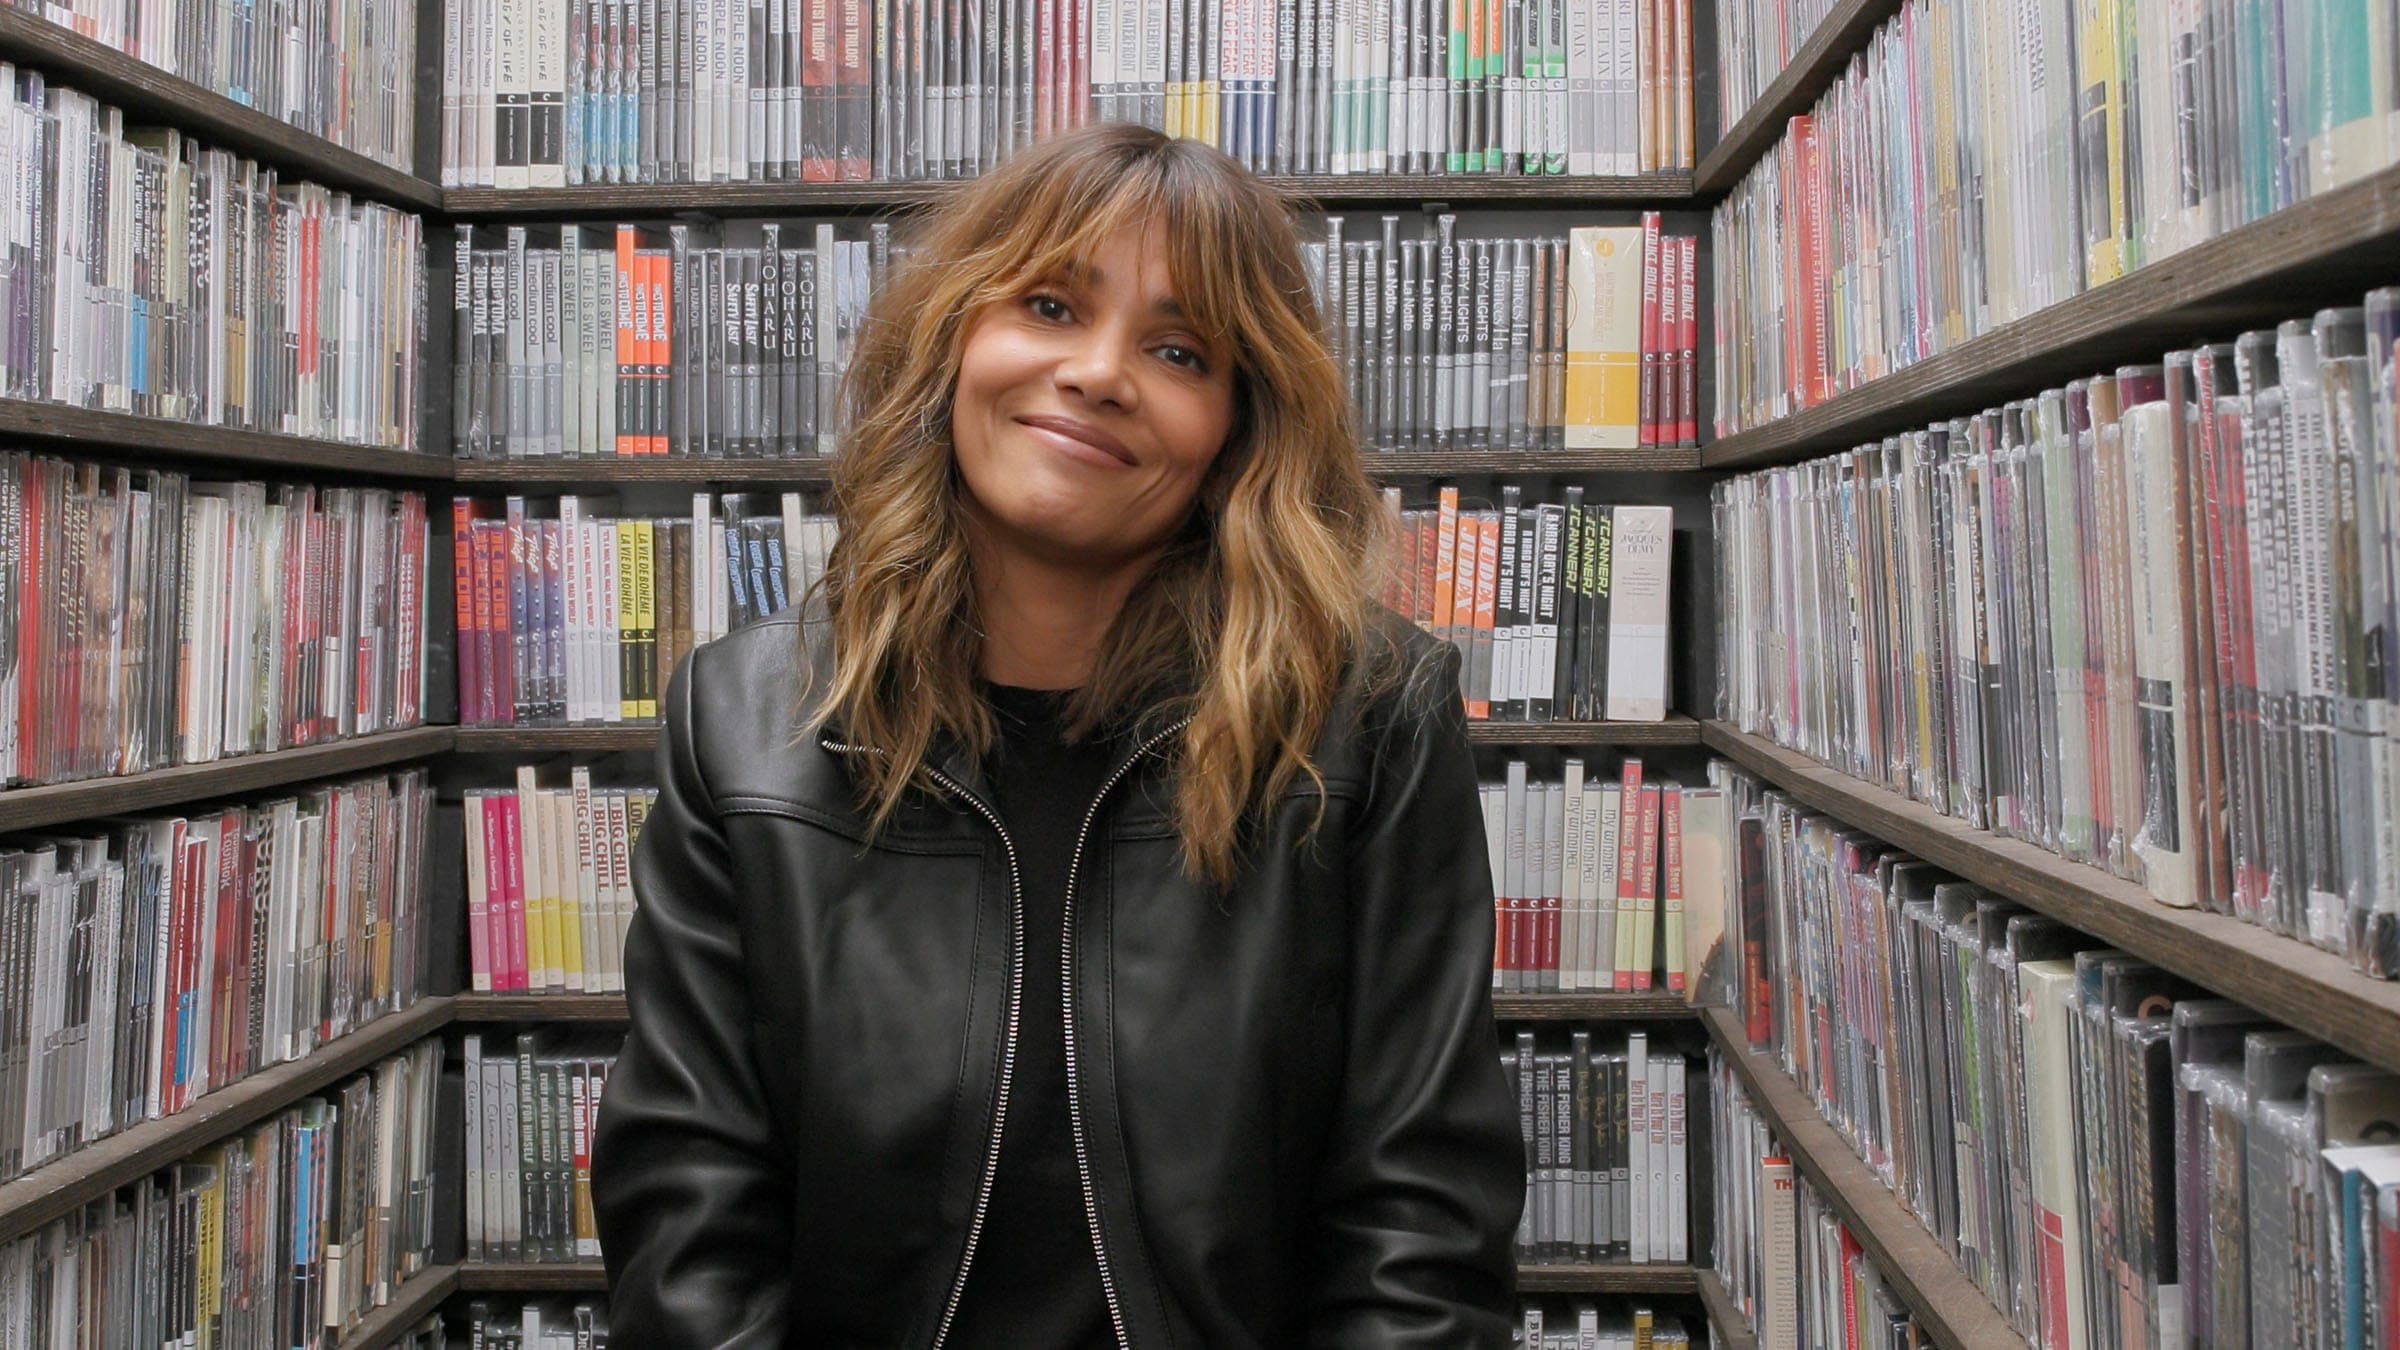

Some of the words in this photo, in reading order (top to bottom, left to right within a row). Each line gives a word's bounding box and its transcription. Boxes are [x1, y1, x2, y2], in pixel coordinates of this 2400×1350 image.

[696, 35, 707, 73] NOON
[715, 42, 726, 79] NOON
[732, 46, 744, 84] NOON
[564, 235, 574, 262] LIFE
[1441, 246, 1453, 279] CITY
[582, 268, 593, 294] LIFE
[600, 264, 610, 290] LIFE
[1386, 260, 1398, 274] La
[1458, 257, 1470, 291] CITY
[1478, 256, 1489, 288] CITY
[456, 268, 469, 310] YUMA
[726, 282, 742, 319] SAFETY
[744, 282, 760, 318] SAFETY
[1403, 280, 1415, 294] La
[1423, 280, 1434, 294] La
[474, 297, 488, 336] YUMA
[491, 297, 505, 335] YUMA
[510, 292, 520, 320] cool
[564, 283, 575, 324] SWEET
[762, 265, 776, 350] OHARU
[800, 280, 814, 356] OHARU
[1403, 298, 1415, 331] Notte
[1422, 298, 1434, 331] Notte
[1440, 284, 1452, 333] LIGHTS
[1476, 294, 1488, 342] LIGHTS
[528, 317, 540, 346] cool
[546, 314, 557, 343] cool
[582, 314, 593, 355] SWEET
[600, 310, 611, 352] SWEET
[782, 282, 796, 358] OHARU
[1458, 296, 1470, 344] LIGHTS
[620, 534, 630, 544] LA
[638, 533, 648, 544] LA
[1436, 500, 1457, 586] JUDEX
[1504, 516, 1517, 544] HARD
[1544, 523, 1558, 552] HARD
[621, 548, 631, 560] VIE
[638, 547, 649, 560] VIE
[1501, 546, 1516, 576] DAY'S
[1522, 538, 1533, 561] HARD
[622, 563, 632, 574] DE
[639, 562, 650, 574] DE
[1456, 526, 1476, 613] JUDEX
[1477, 530, 1496, 618] JUDEX
[1542, 553, 1556, 584] DAY'S
[1499, 578, 1513, 610] NIGHT
[1518, 588, 1530, 614] NIGHT
[1540, 586, 1555, 618] NIGHT
[575, 788, 588, 818] BIG
[594, 810, 608, 839] BIG
[612, 808, 625, 838] BIG
[578, 820, 592, 872] CHILL
[596, 842, 610, 892] CHILL
[614, 841, 628, 892] CHILL
[1520, 1072, 1533, 1112] FISHER
[1536, 1069, 1550, 1092] THE
[1558, 1068, 1570, 1091] THE
[1537, 1094, 1550, 1135] FISHER
[1558, 1094, 1571, 1134] FISHER
[1538, 1138, 1551, 1164] KING
[1559, 1137, 1572, 1164] KING
